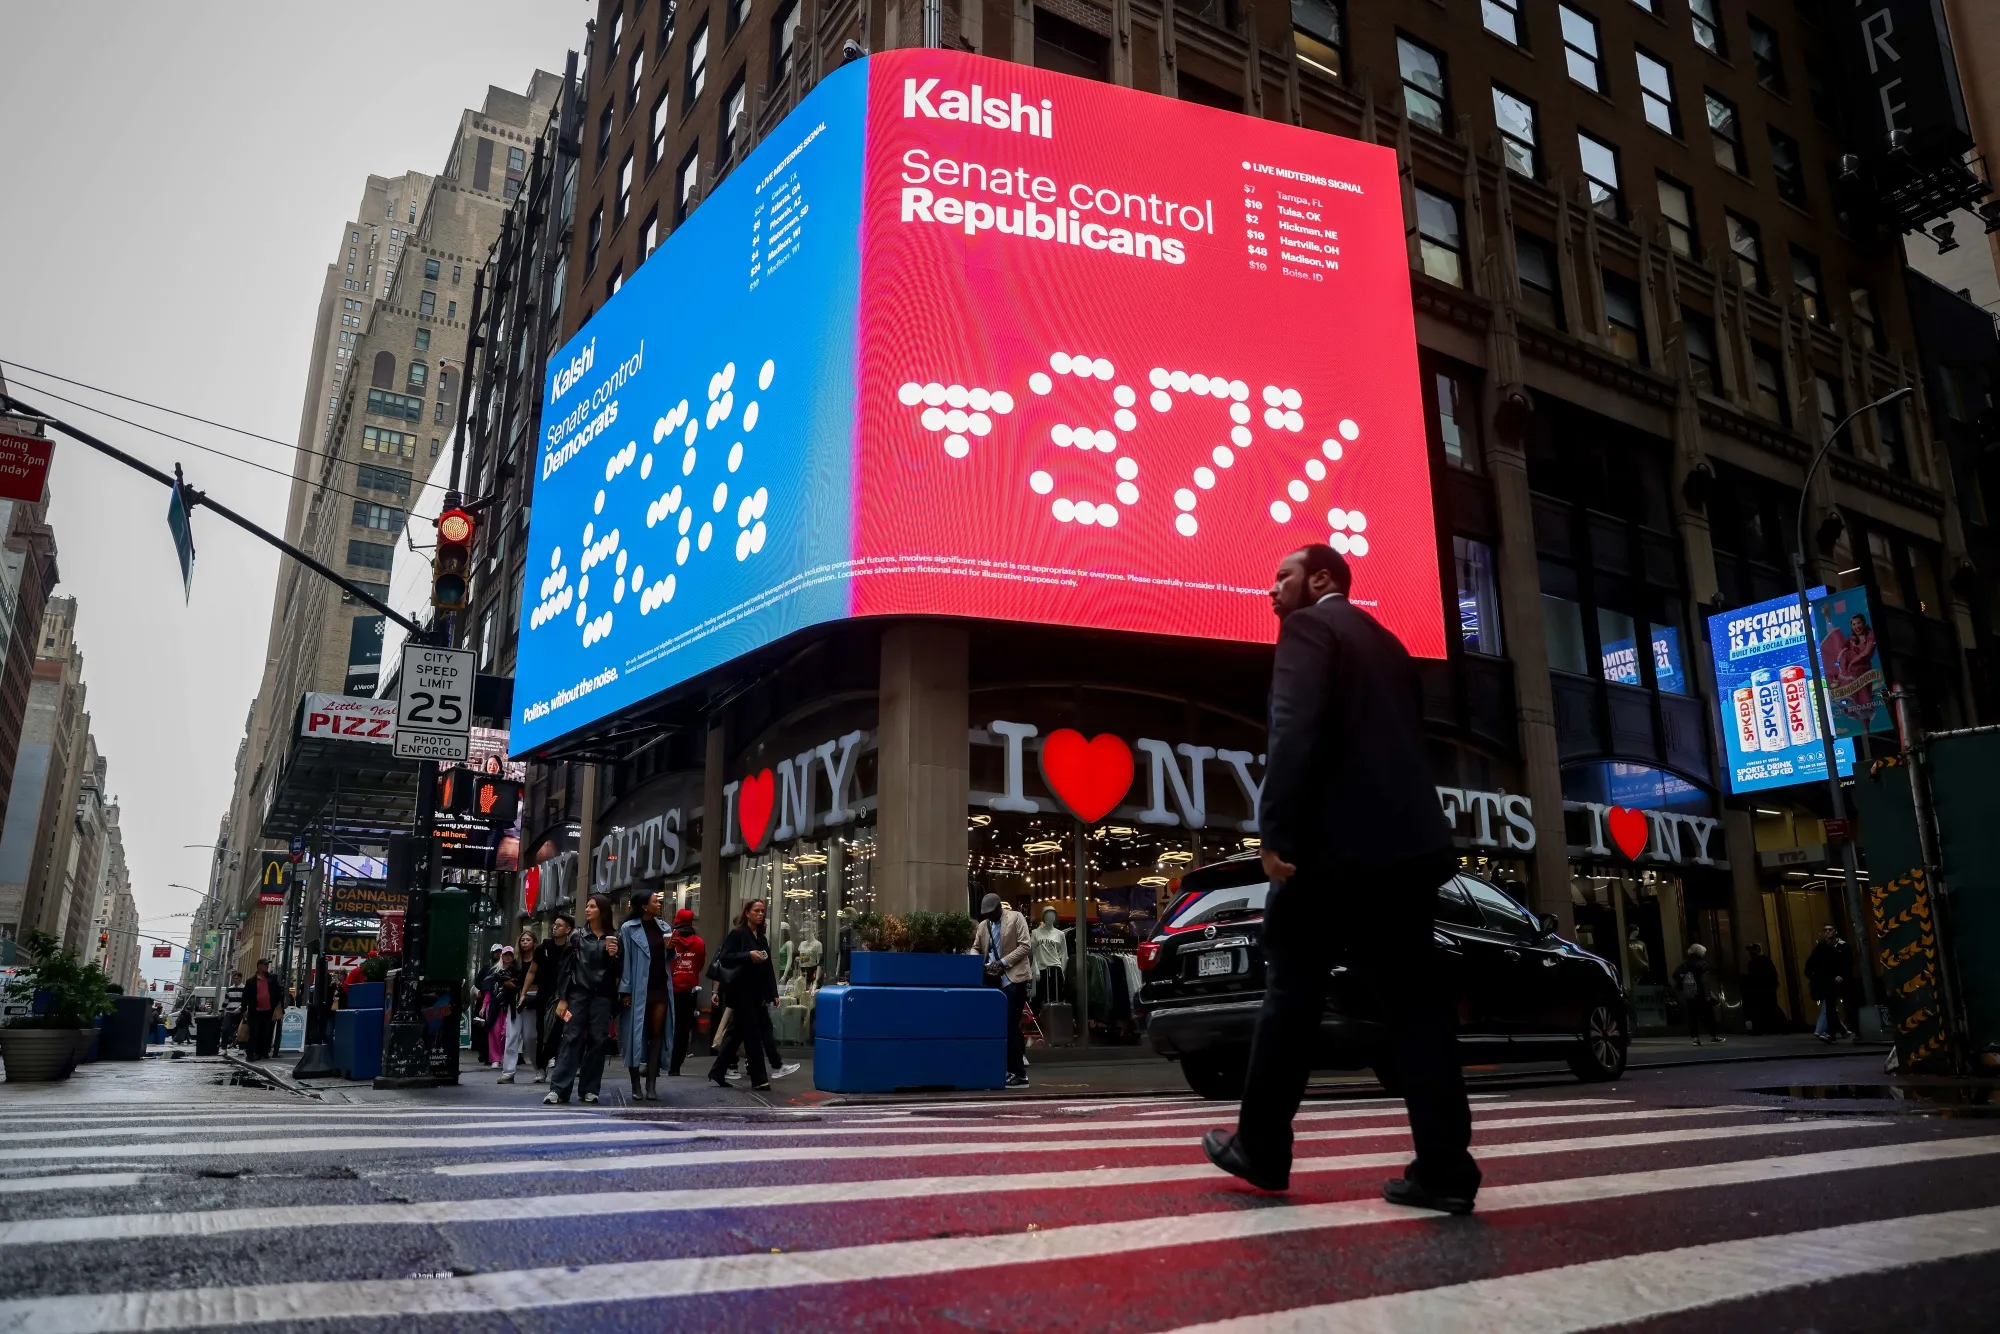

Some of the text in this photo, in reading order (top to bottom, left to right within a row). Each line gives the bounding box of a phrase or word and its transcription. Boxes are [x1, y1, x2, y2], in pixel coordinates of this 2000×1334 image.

[903, 78, 1053, 139] Kalshi
[1253, 163, 1364, 194] LIVE MIDTERMS SIGNAL
[901, 148, 1214, 234] Senate control
[1244, 184, 1256, 193] $7
[1245, 198, 1263, 210] $10
[1277, 191, 1323, 208] Tampa, FL
[1246, 213, 1259, 224] $2
[1277, 206, 1321, 222] Tulsa, OK
[900, 187, 1186, 265] Republicans
[1247, 229, 1265, 241] $10
[1279, 221, 1338, 240] Hickman, NE
[1248, 244, 1268, 256] $48
[1280, 236, 1340, 255] Hartville, OH
[1249, 260, 1267, 272] $10
[1281, 251, 1339, 270] Madison, WI
[1312, 273, 1324, 282] ID
[550, 336, 596, 405] Kalshi
[546, 339, 644, 452] Senate control
[542, 398, 618, 482] Democrats
[802, 575, 837, 589] information.
[837, 568, 873, 579] Locations
[874, 566, 901, 574] shown
[917, 565, 951, 574] fictional
[952, 567, 968, 575] and
[982, 570, 1022, 580] illustrative
[1023, 574, 1059, 584] purposes
[1060, 578, 1078, 587] only.
[804, 564, 831, 577] including
[831, 557, 865, 569] perpetual
[866, 556, 898, 565] futures,
[898, 554, 933, 562] involves
[934, 555, 976, 565] significant
[977, 558, 991, 567] risk
[993, 561, 1008, 569] and
[1031, 565, 1077, 576] appropriate
[1077, 569, 1088, 577] for
[1089, 572, 1126, 581] everyone.
[1127, 574, 1151, 584] Please
[1152, 577, 1184, 588] carefully
[1184, 581, 1215, 590] consider
[1731, 634, 1744, 650] IS
[1748, 631, 1758, 647] A
[1731, 650, 1748, 658] BUILT
[1763, 641, 1783, 651] SOCIAL
[423, 652, 454, 664] CITY
[416, 664, 458, 678] SPEED
[419, 677, 453, 690] LIMIT
[1797, 681, 1806, 699] ADE
[523, 666, 619, 725] Politics, without the noise.
[1771, 684, 1780, 703] ADE
[322, 701, 362, 711] Little
[407, 691, 463, 725] 25
[308, 712, 394, 739] PIZZ
[401, 744, 462, 757] ENFORCED
[413, 735, 451, 747] PHOTO
[988, 719, 1267, 833] I NY
[1736, 764, 1765, 776] SPORTS
[1766, 760, 1793, 772] DRINK
[721, 729, 866, 857] I NY
[450, 831, 468, 839] here.
[1585, 802, 1719, 866] I NY
[594, 807, 682, 893] GIFTS
[539, 851, 577, 911] NY
